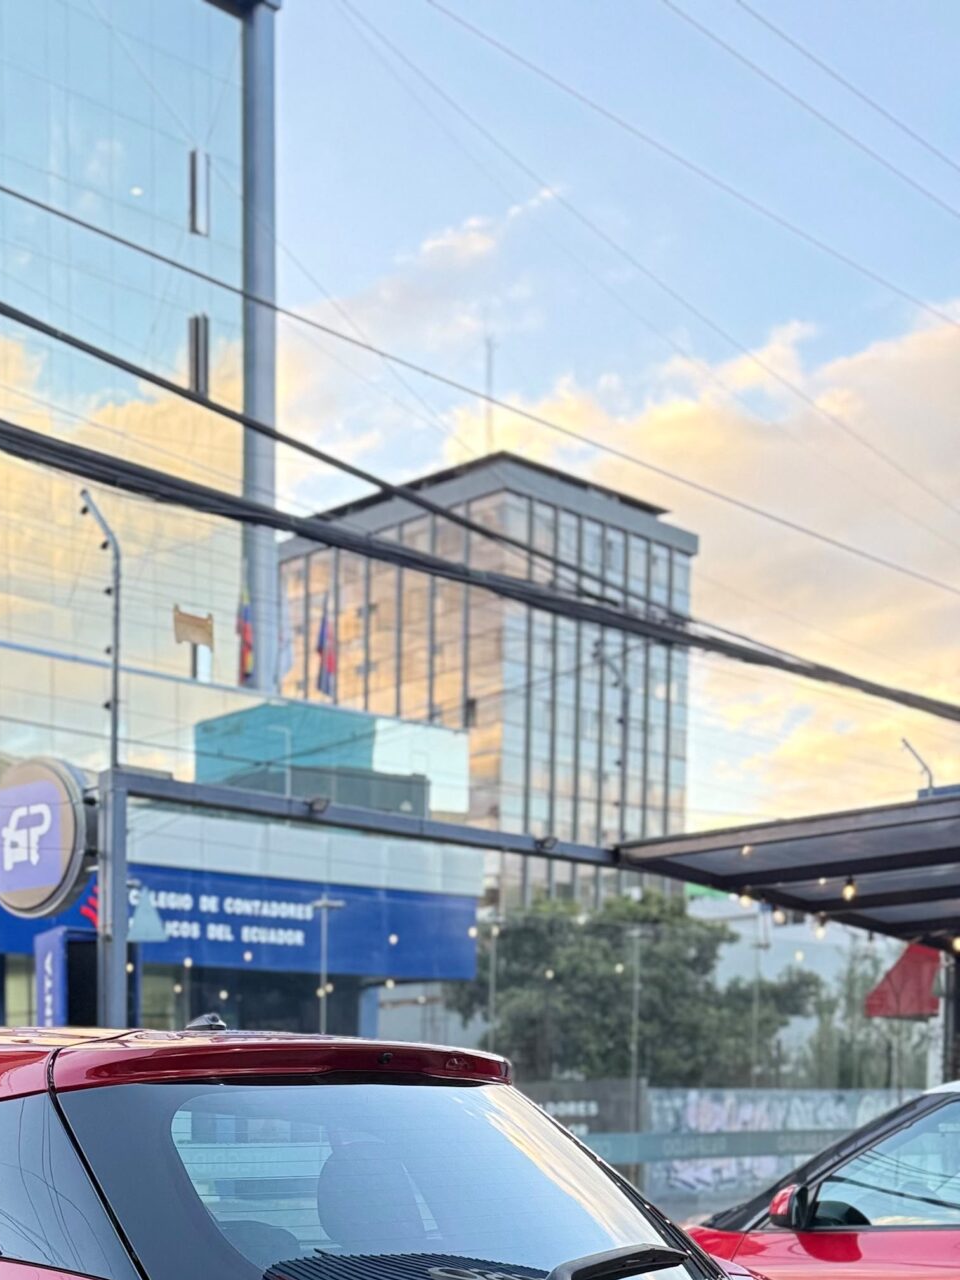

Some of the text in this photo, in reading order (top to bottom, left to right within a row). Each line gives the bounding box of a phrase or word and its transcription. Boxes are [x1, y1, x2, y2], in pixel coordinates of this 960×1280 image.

[128, 888, 314, 921] CLEGIO DE CONTADORES
[207, 923, 234, 942] DEL
[241, 926, 305, 947] ECUADOR
